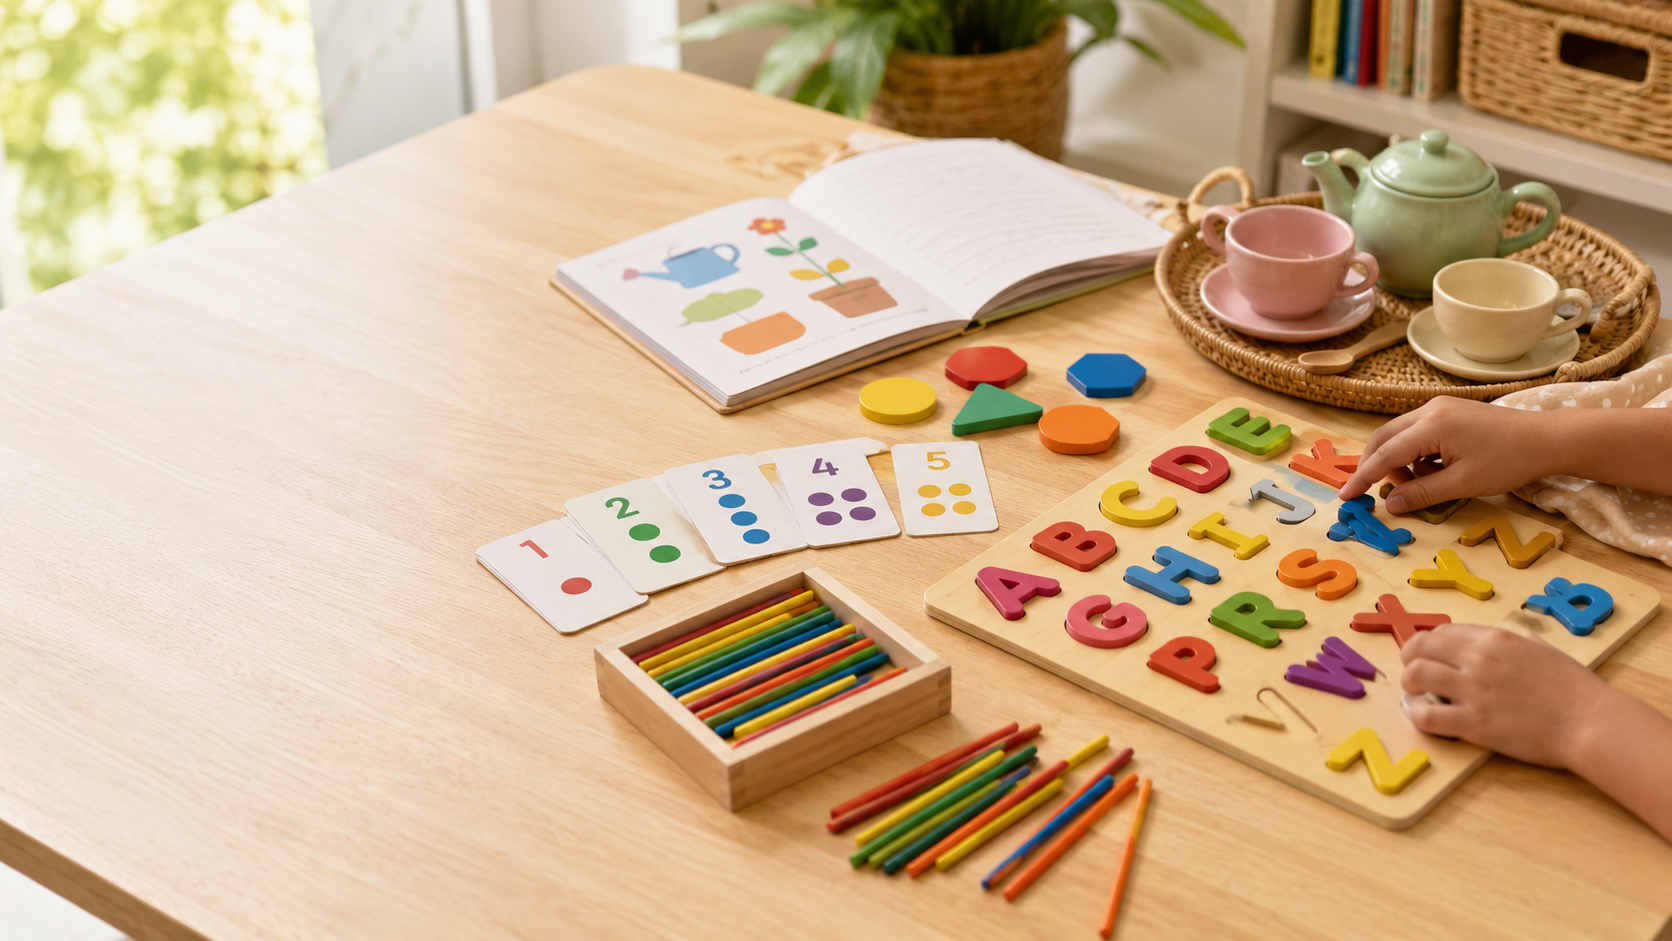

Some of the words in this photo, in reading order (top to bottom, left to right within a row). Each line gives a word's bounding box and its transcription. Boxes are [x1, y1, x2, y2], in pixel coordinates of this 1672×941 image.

[702, 469, 732, 489] 3
[812, 457, 839, 477] 4
[926, 451, 950, 470] 5
[605, 496, 639, 519] 2
[975, 567, 1061, 620] A
[1031, 522, 1117, 571] B
[1099, 481, 1178, 527] C
[1149, 446, 1230, 493] D
[1206, 408, 1292, 457] E
[519, 539, 549, 559] 1
[1065, 595, 1149, 649] G
[1124, 546, 1220, 605] H
[1187, 512, 1271, 560] I
[1249, 479, 1315, 525] J
[1289, 439, 1361, 490] K
[1147, 637, 1220, 693] P
[1208, 592, 1308, 649] R
[1277, 548, 1358, 600] S
[1284, 636, 1377, 700] W
[1350, 593, 1452, 651] X
[1408, 548, 1495, 600] Y
[1326, 728, 1430, 795] Z
